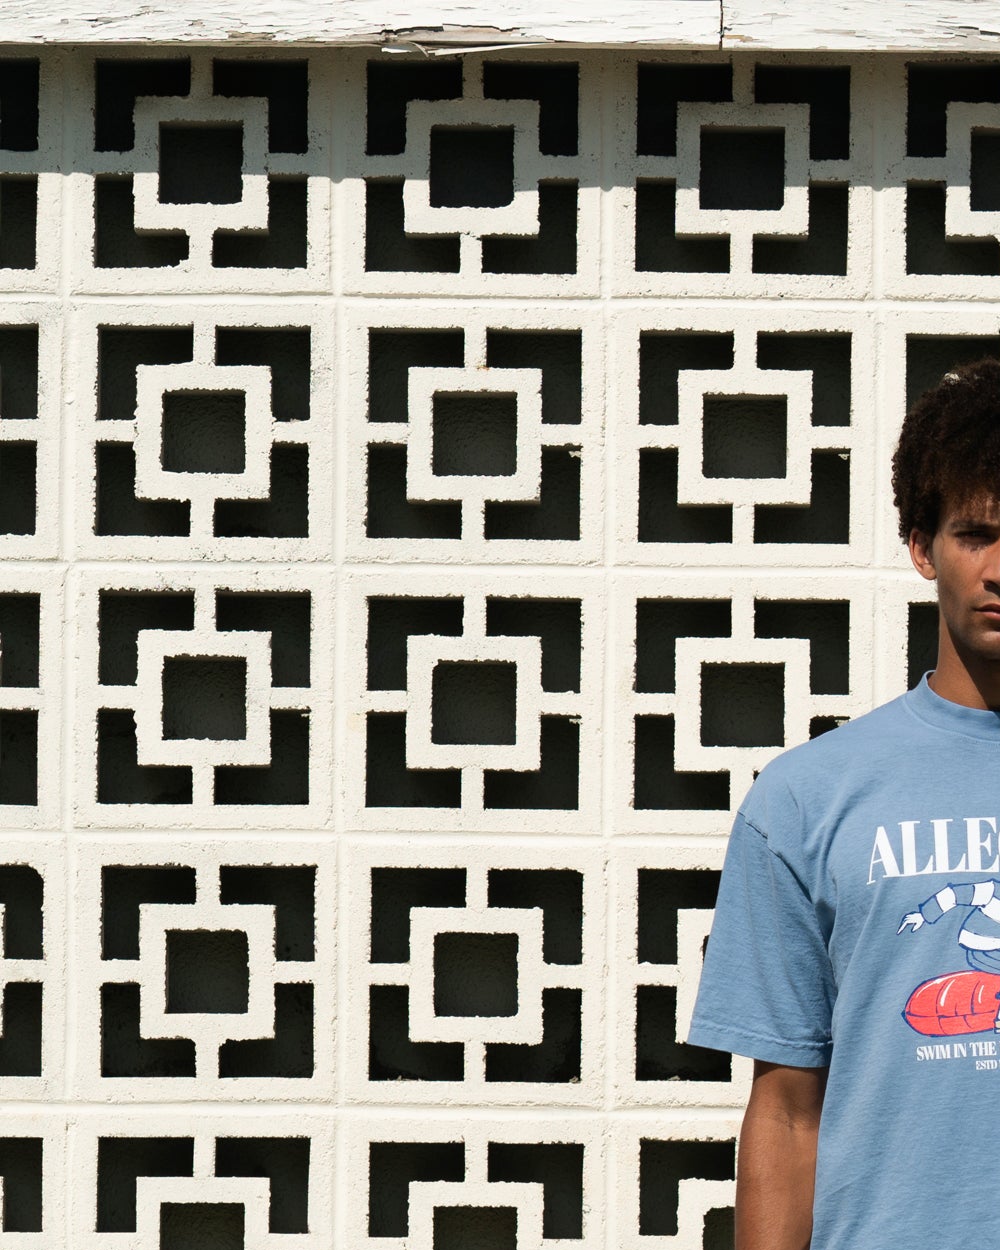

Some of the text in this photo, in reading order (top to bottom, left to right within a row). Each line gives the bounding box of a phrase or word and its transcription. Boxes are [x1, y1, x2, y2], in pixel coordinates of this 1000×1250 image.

[916, 1044, 951, 1061] SWIM
[953, 1043, 967, 1058] IN
[969, 1041, 996, 1057] THE
